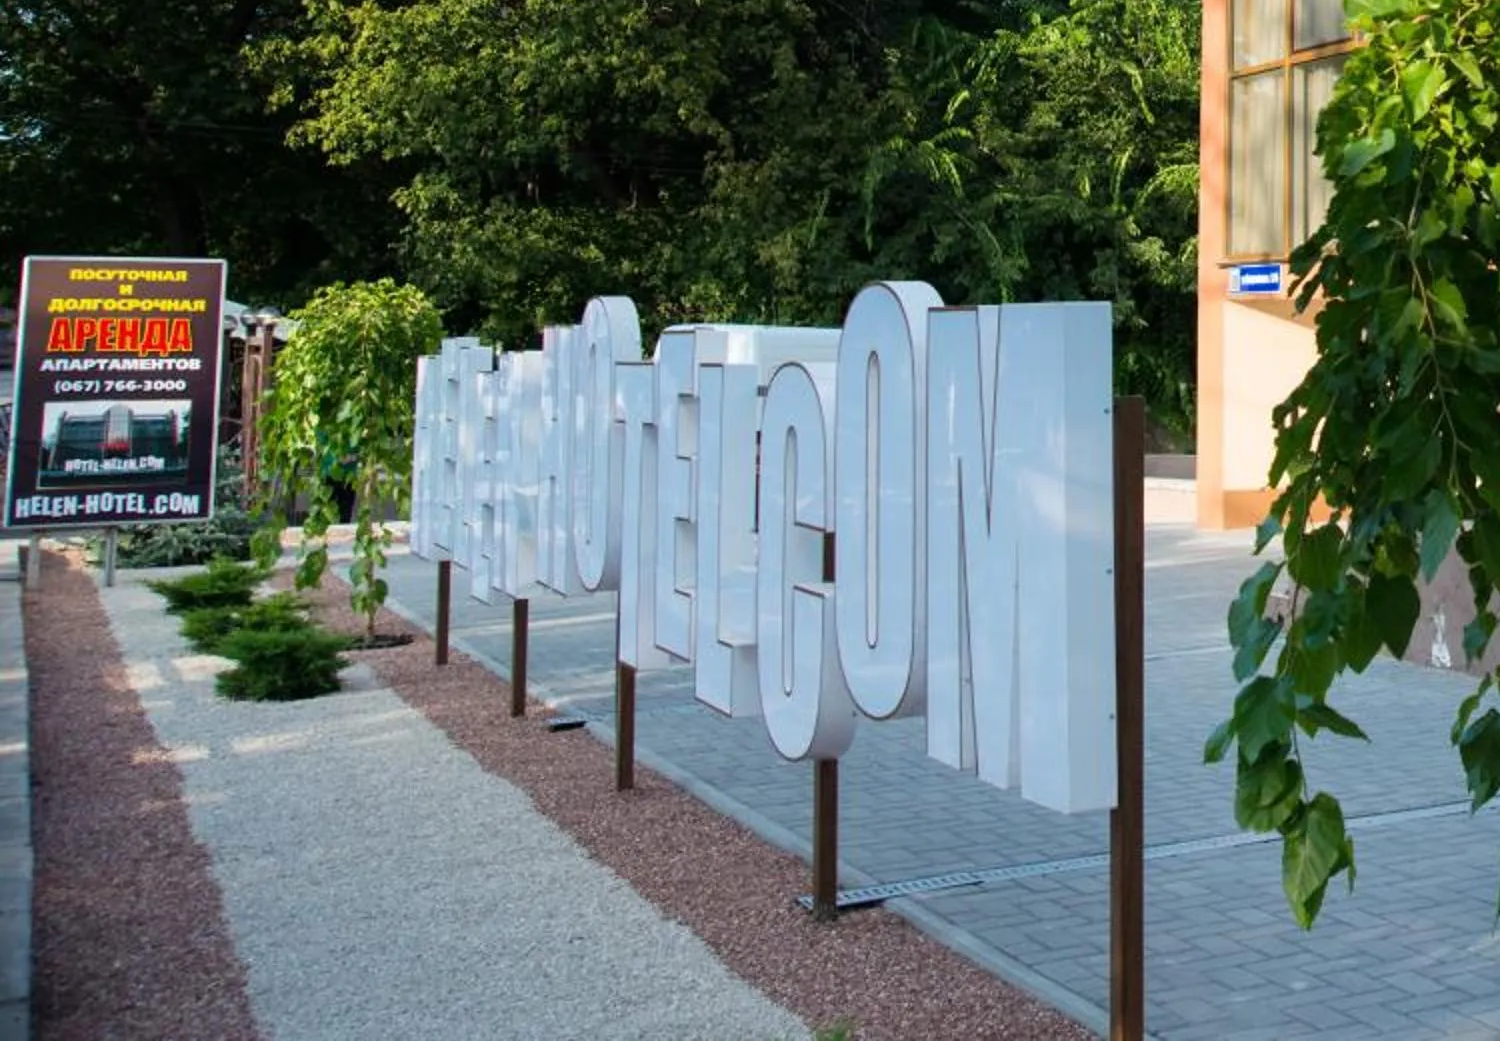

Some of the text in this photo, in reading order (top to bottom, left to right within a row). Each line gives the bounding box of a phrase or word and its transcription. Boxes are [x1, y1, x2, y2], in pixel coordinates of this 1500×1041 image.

[69, 268, 188, 282] ПОСУТОЧНАЯ
[119, 284, 133, 296] И
[48, 297, 206, 313] ДОЛГОСРОЧНАЯ
[47, 316, 193, 357] АРЕНДА
[40, 358, 202, 372] АПАРТАМЕНТОВ
[55, 379, 187, 394] (067) 766-3000
[15, 491, 200, 518] HELEN-HOTEL.COM
